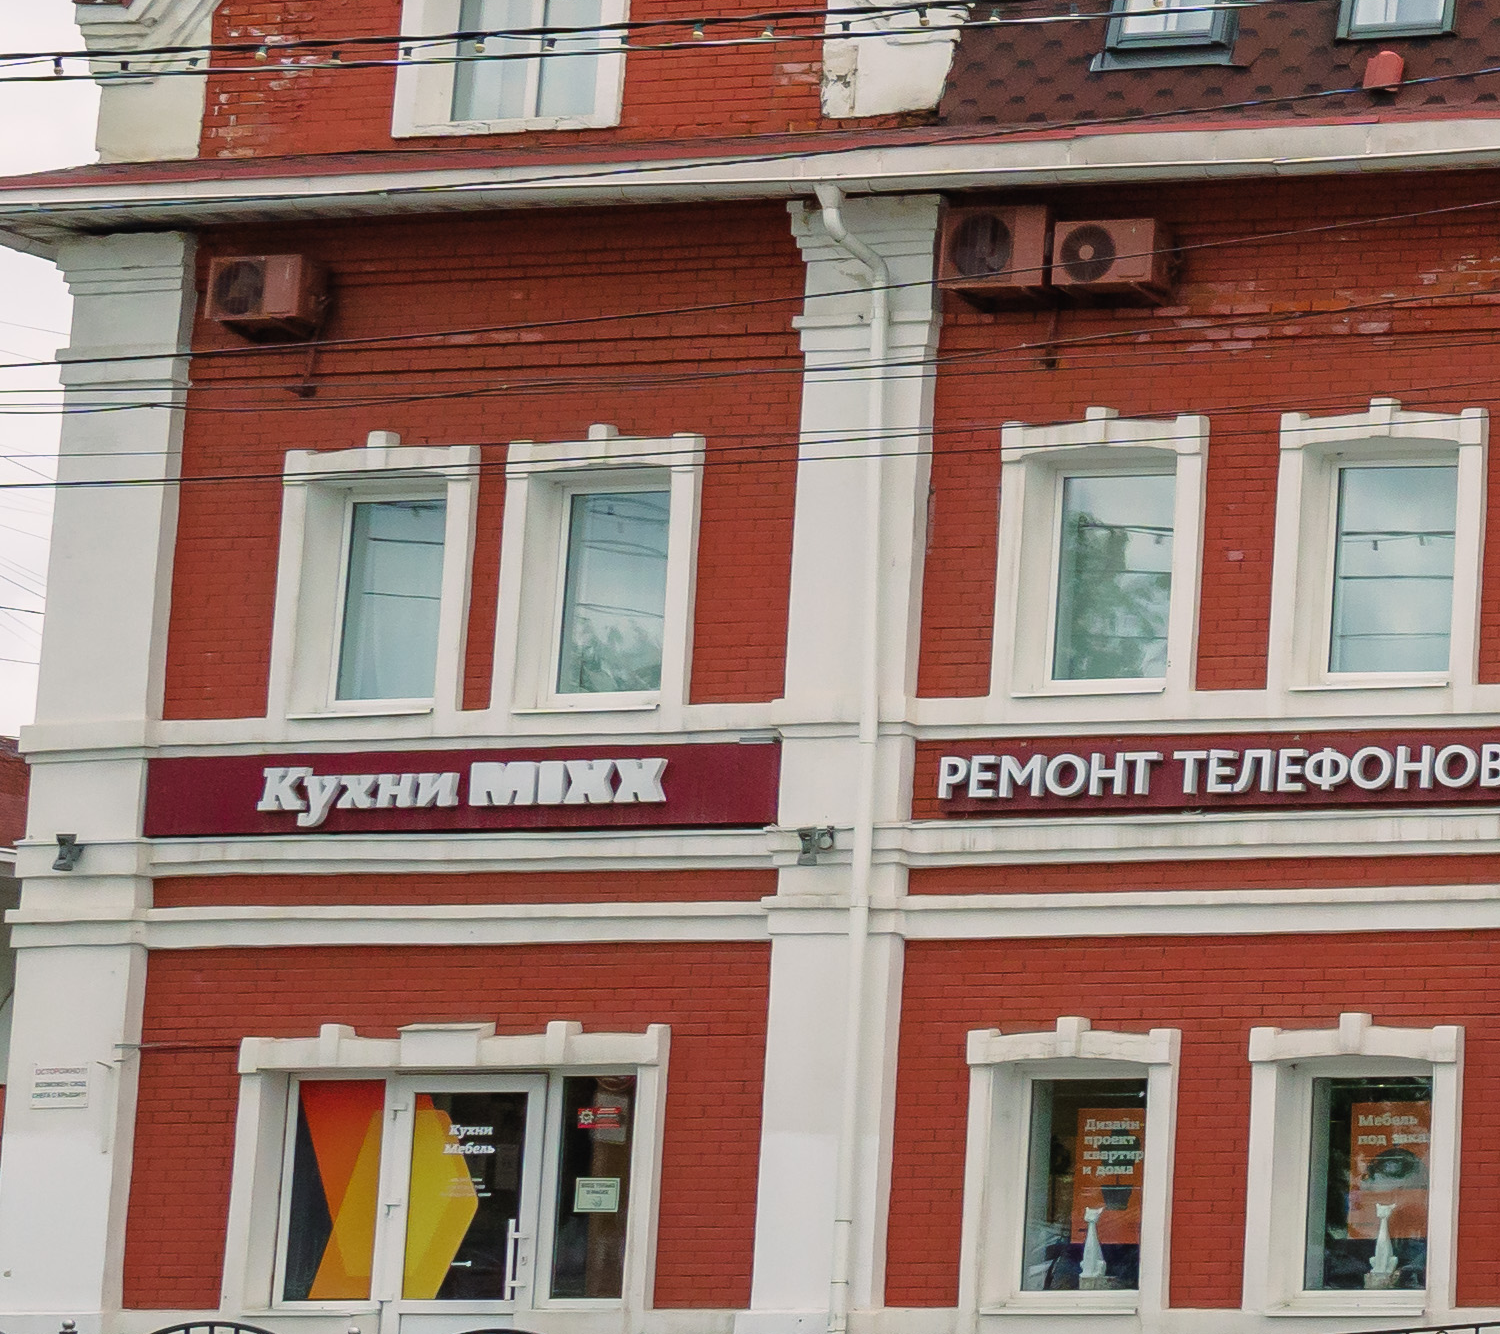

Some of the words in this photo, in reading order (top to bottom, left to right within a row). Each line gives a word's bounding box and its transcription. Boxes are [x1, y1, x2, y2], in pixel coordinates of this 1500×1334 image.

[937, 751, 1163, 799] РЕМОНТ
[257, 766, 460, 827] Кухни
[468, 758, 669, 806] MIXX
[1358, 1112, 1418, 1127] Мебель
[448, 1124, 494, 1139] Кухни
[1084, 1135, 1136, 1148] проект
[1358, 1134, 1387, 1146] под
[442, 1142, 496, 1155] Мебель
[1083, 1150, 1144, 1163] квартир
[1096, 1165, 1134, 1177] дома
